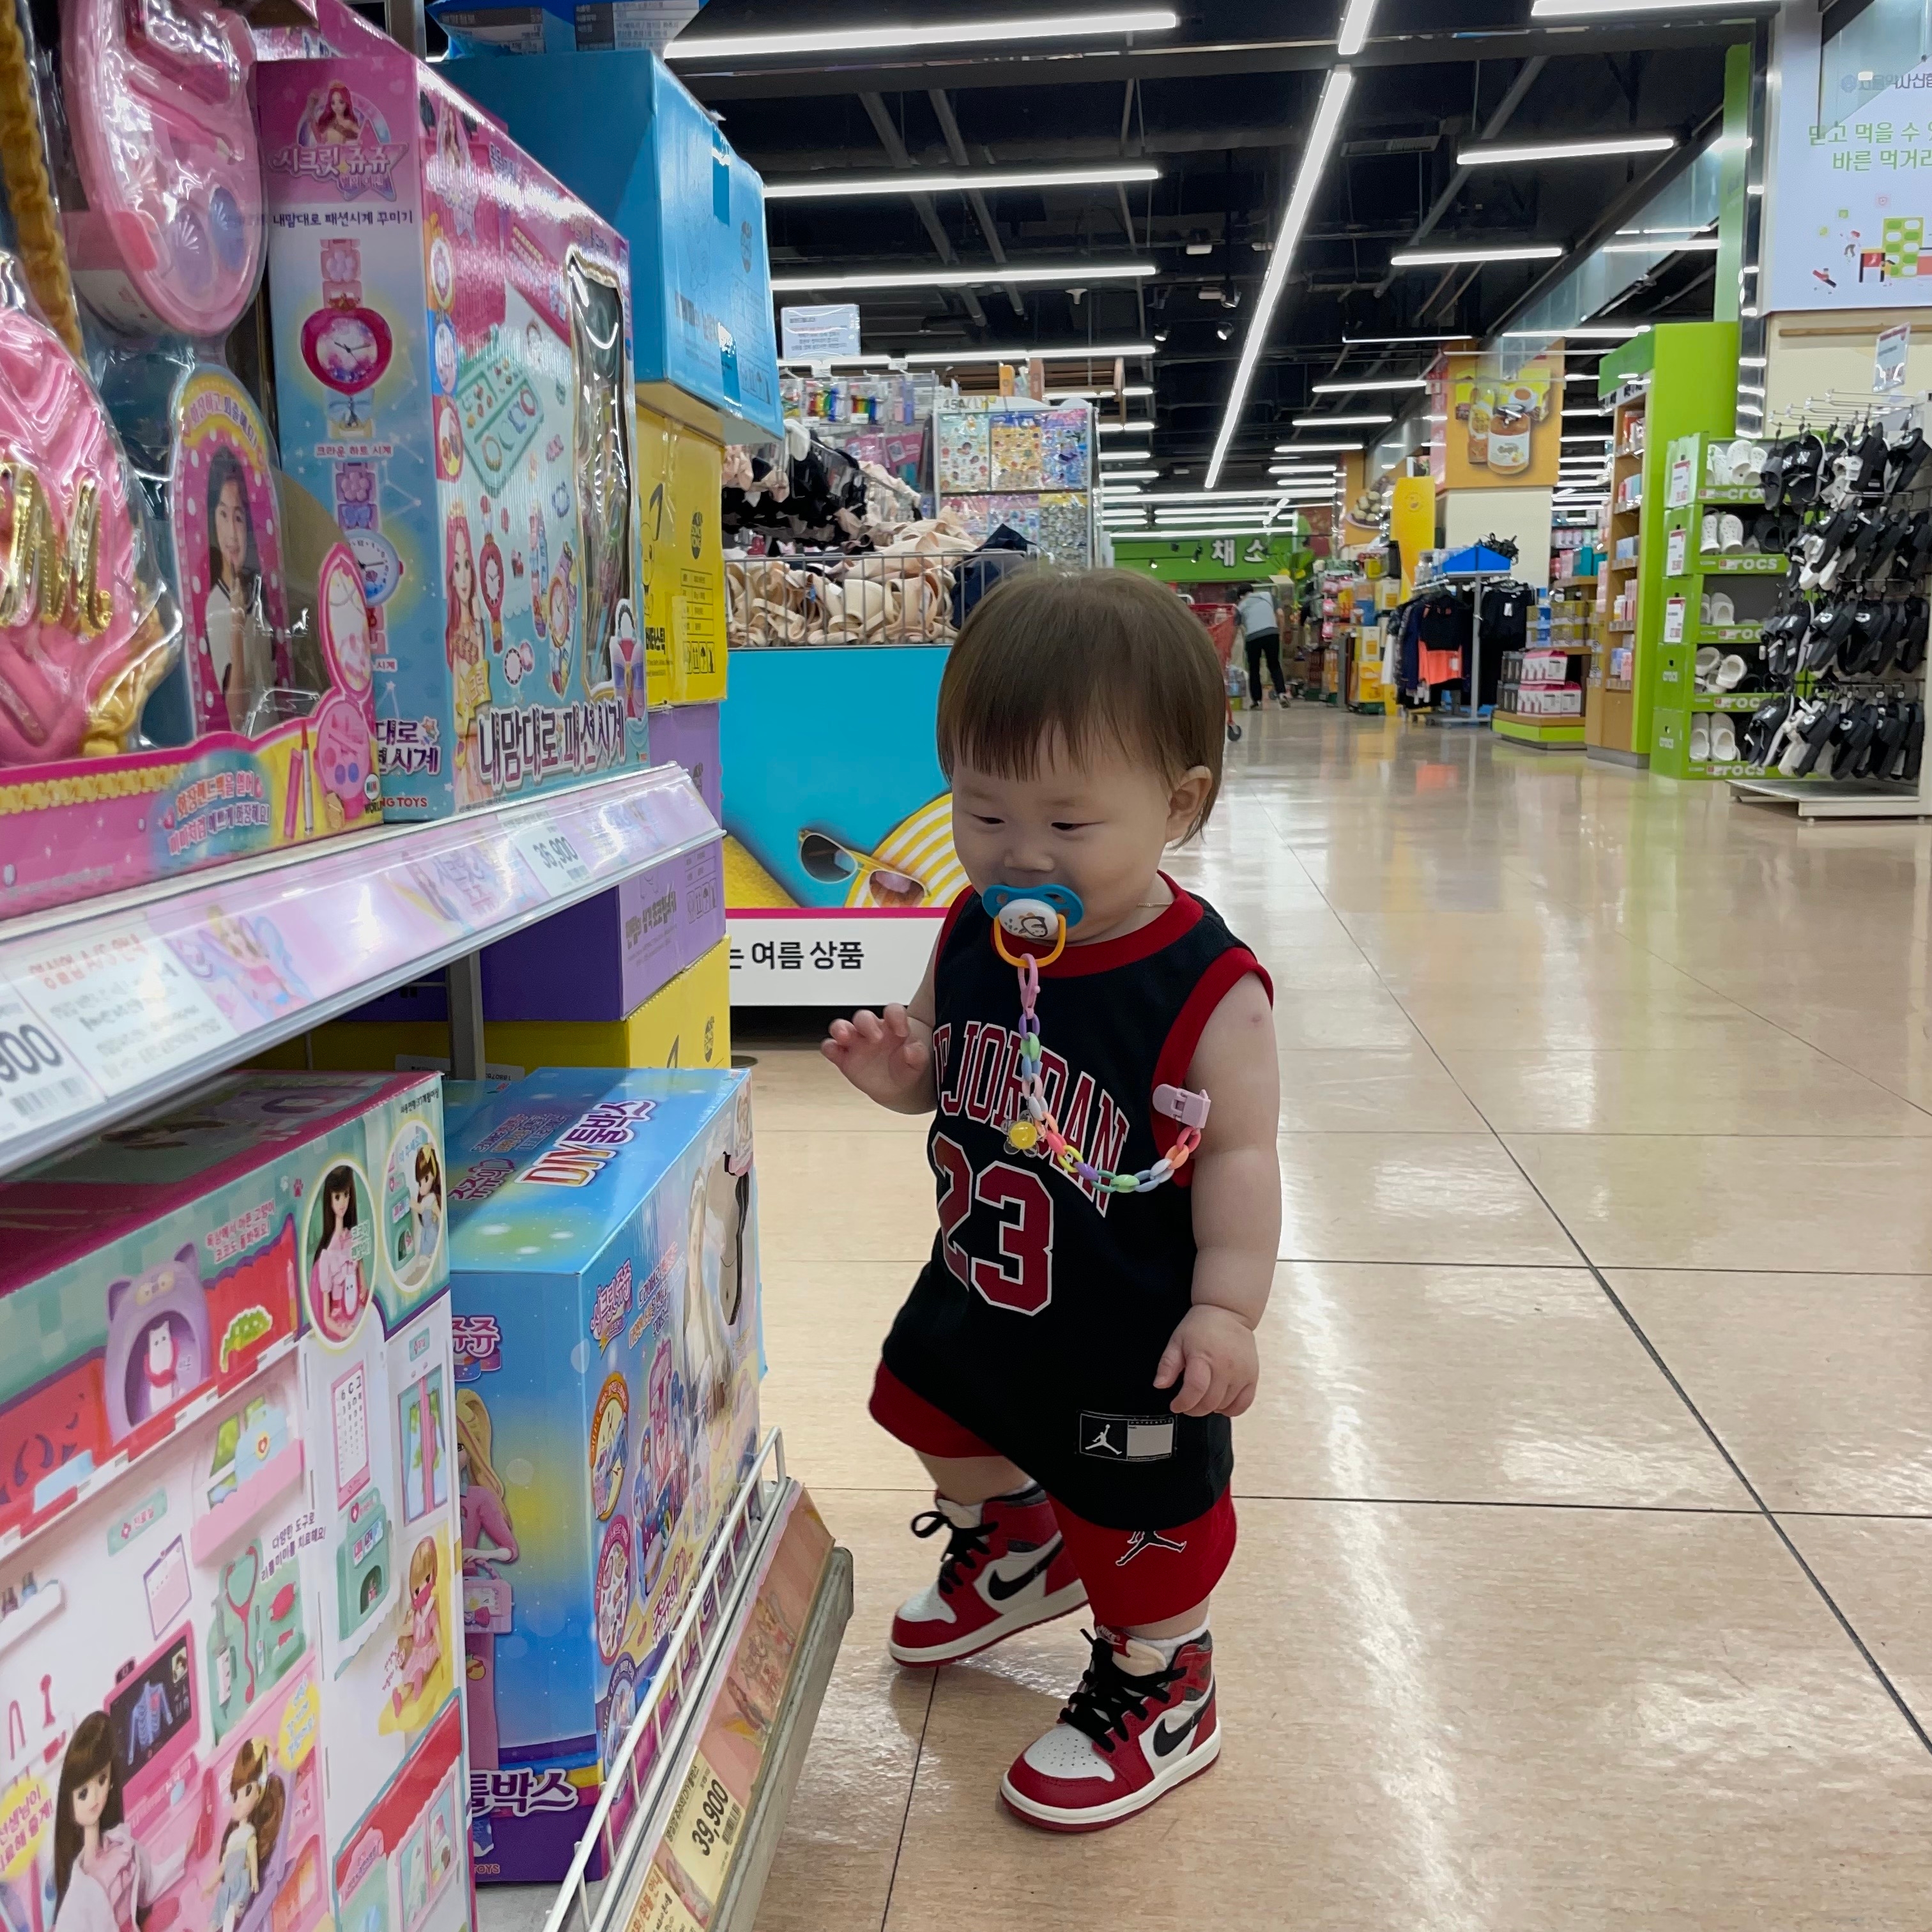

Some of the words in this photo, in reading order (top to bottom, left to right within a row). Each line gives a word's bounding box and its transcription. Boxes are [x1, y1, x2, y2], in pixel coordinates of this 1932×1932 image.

[1855, 121, 1892, 144] 먹을
[1900, 123, 1919, 142] 수
[272, 148, 340, 176] 시크릿
[348, 147, 390, 175] 쥬쥬
[1832, 150, 1871, 171] 바른
[273, 211, 321, 228] 내맘대로
[325, 211, 374, 227] 패션시계
[376, 210, 413, 224] 꾸미기
[376, 719, 420, 746] 대로
[480, 707, 560, 784] 내맘대로
[563, 699, 625, 769] 패션시계
[397, 797, 427, 808] TOYS
[533, 836, 579, 870] 36,900
[752, 941, 804, 970] 여름
[810, 941, 864, 970] 상품
[562, 1101, 652, 1144] 툴박스
[520, 1143, 611, 1186] DIY
[931, 1131, 1054, 1317] 23
[272, 1524, 293, 1549] 다양한
[295, 1512, 315, 1532] 도구로
[471, 1772, 576, 1814] 툴박스
[692, 1779, 728, 1856] 39,900
